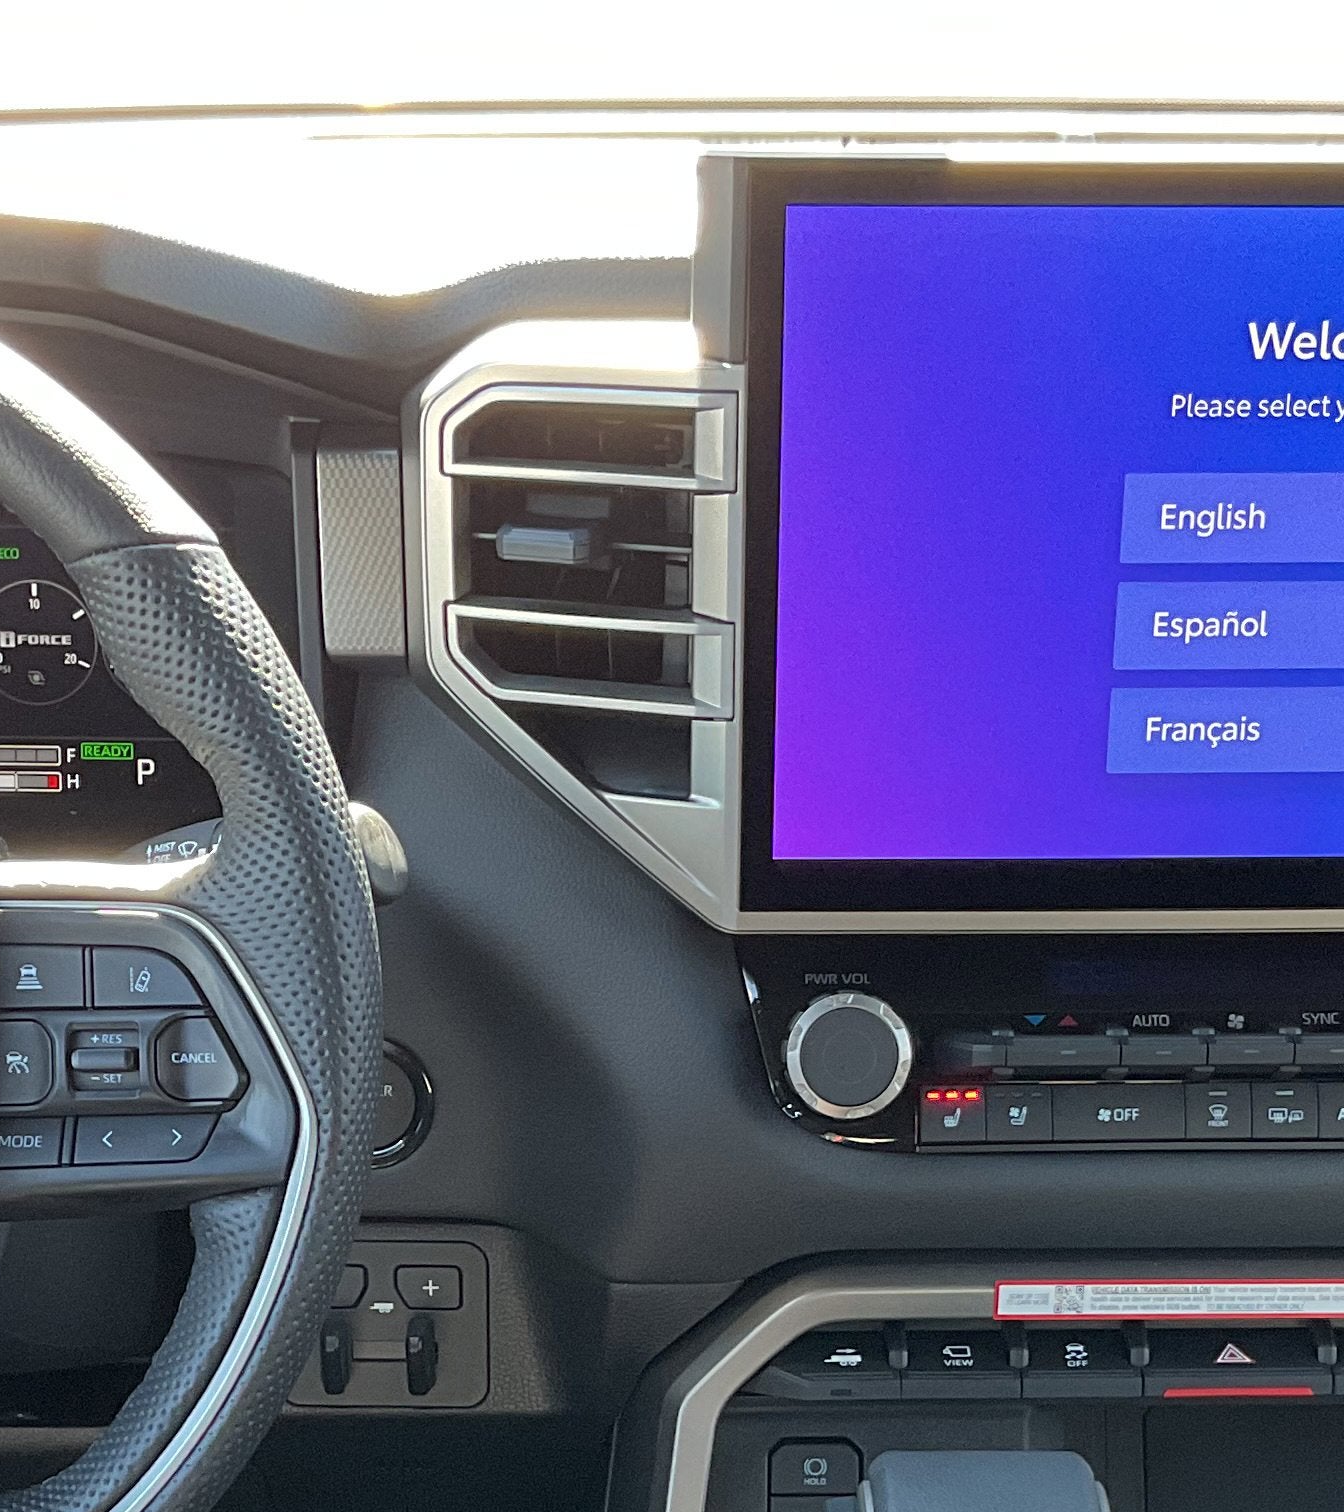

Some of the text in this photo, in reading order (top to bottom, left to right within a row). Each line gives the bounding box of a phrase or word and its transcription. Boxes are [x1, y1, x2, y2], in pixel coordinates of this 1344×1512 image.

[1171, 394, 1251, 418] Please
[1258, 394, 1330, 418] select
[1160, 502, 1266, 537] English
[28, 599, 41, 610] 10
[1152, 610, 1269, 644] Español
[64, 653, 77, 665] 20
[1145, 715, 1261, 748] Français
[67, 748, 76, 762] F
[84, 745, 130, 758] READY
[137, 758, 155, 785] P
[67, 774, 80, 788] H
[804, 973, 871, 985] PWR VOL
[1132, 1014, 1170, 1028] AUTO
[1302, 1011, 1340, 1026] SYNC
[171, 1051, 217, 1064] CANCEL
[1113, 1107, 1140, 1122] OFF
[943, 1359, 974, 1367] VIEW
[1067, 1360, 1088, 1368] OFF
[804, 1477, 827, 1486] HOLD
